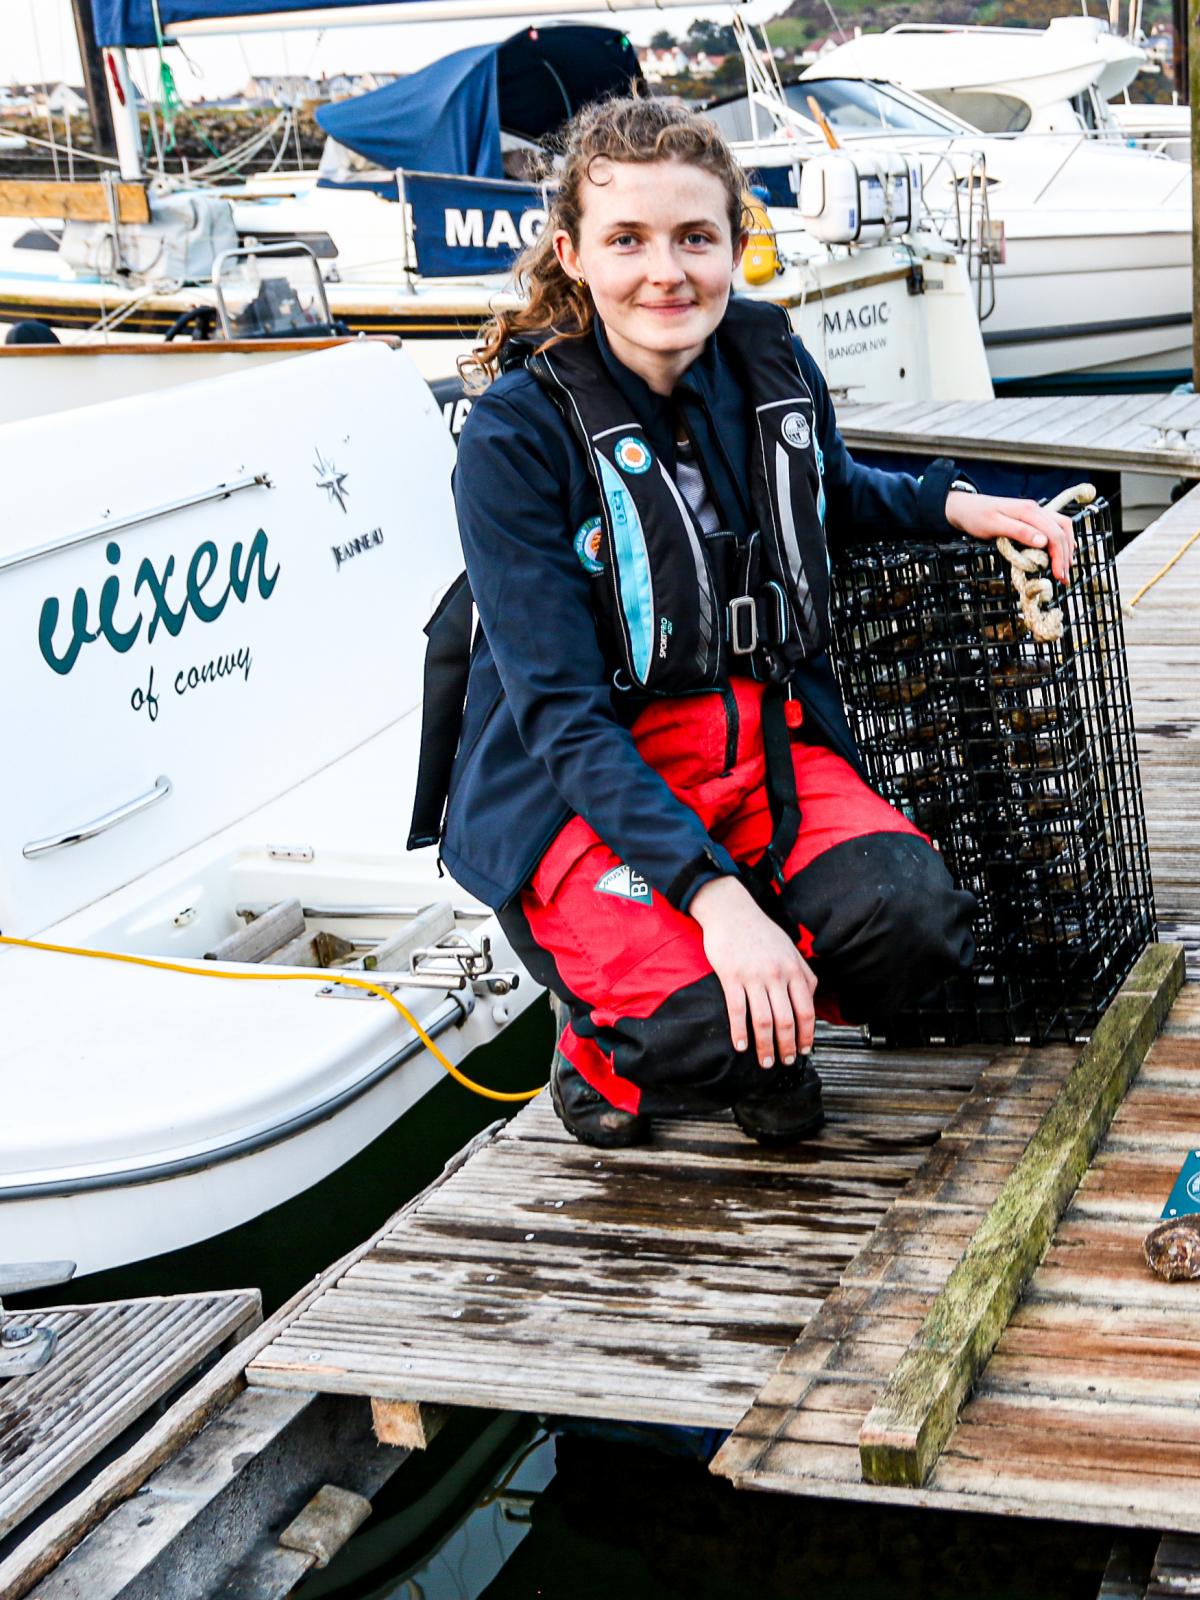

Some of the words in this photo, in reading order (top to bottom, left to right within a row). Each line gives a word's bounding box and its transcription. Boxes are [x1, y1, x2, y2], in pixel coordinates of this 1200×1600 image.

[444, 208, 549, 248] MAG
[823, 301, 889, 334] MAGIC
[828, 342, 868, 360] BANGOR
[331, 527, 384, 573] JEANNEAU
[38, 528, 281, 675] vixen
[130, 665, 159, 722] of
[174, 646, 252, 695] conwy
